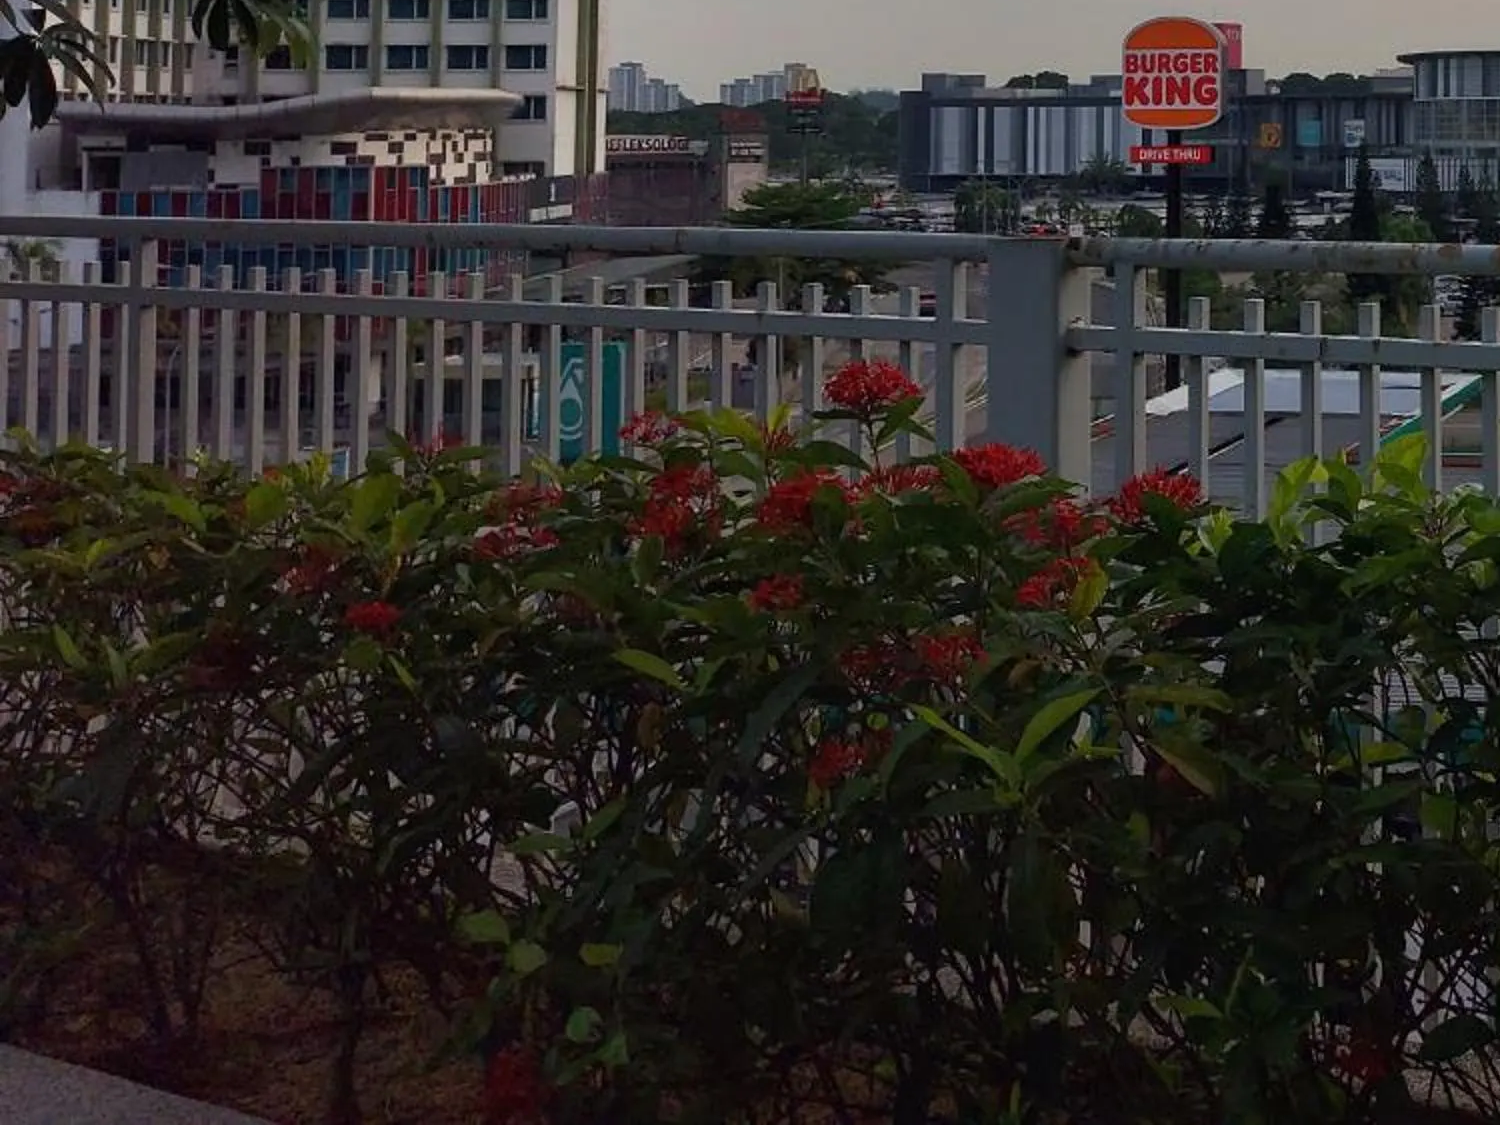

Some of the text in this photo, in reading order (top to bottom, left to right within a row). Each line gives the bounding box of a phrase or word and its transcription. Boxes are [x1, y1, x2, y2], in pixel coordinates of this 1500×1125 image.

[1124, 53, 1218, 74] BURGER
[1124, 75, 1218, 106] KING
[1138, 148, 1201, 161] DRIVE THRU
